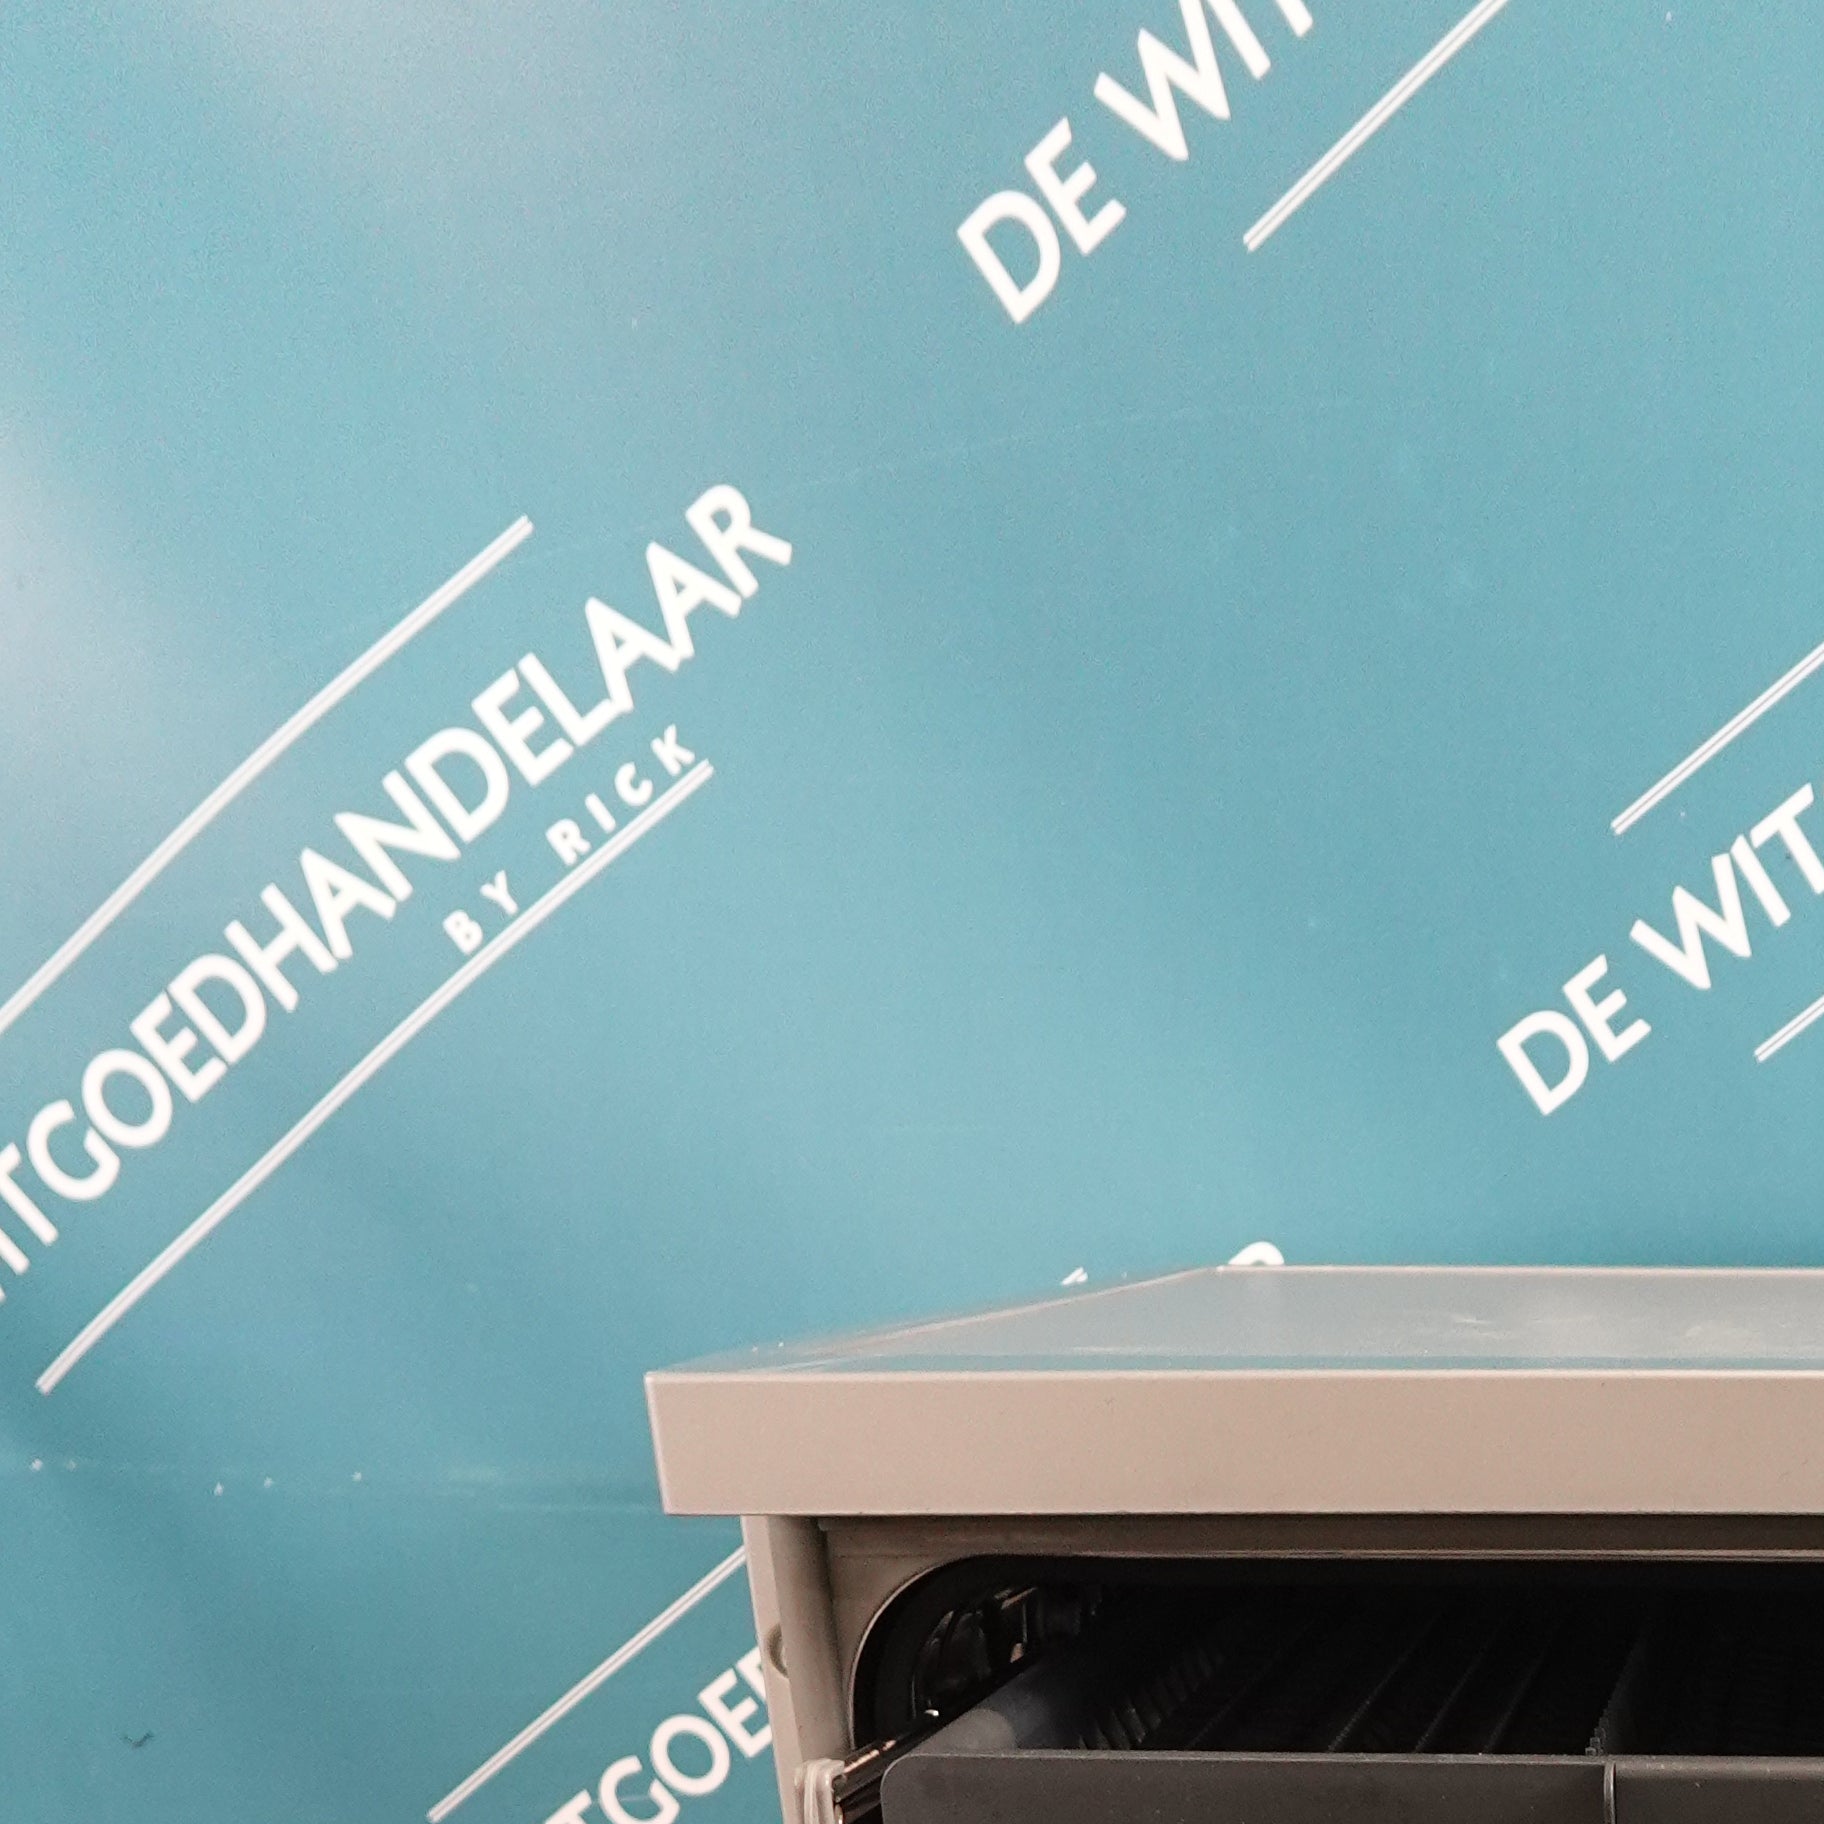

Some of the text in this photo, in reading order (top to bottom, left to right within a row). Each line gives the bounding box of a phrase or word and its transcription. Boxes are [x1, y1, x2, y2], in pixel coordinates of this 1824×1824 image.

[956, 116, 1128, 325] DE
[0, 484, 793, 1304] TGOEDHANDELAAR
[443, 724, 696, 955] BY RICK
[1496, 953, 1652, 1116] DE
